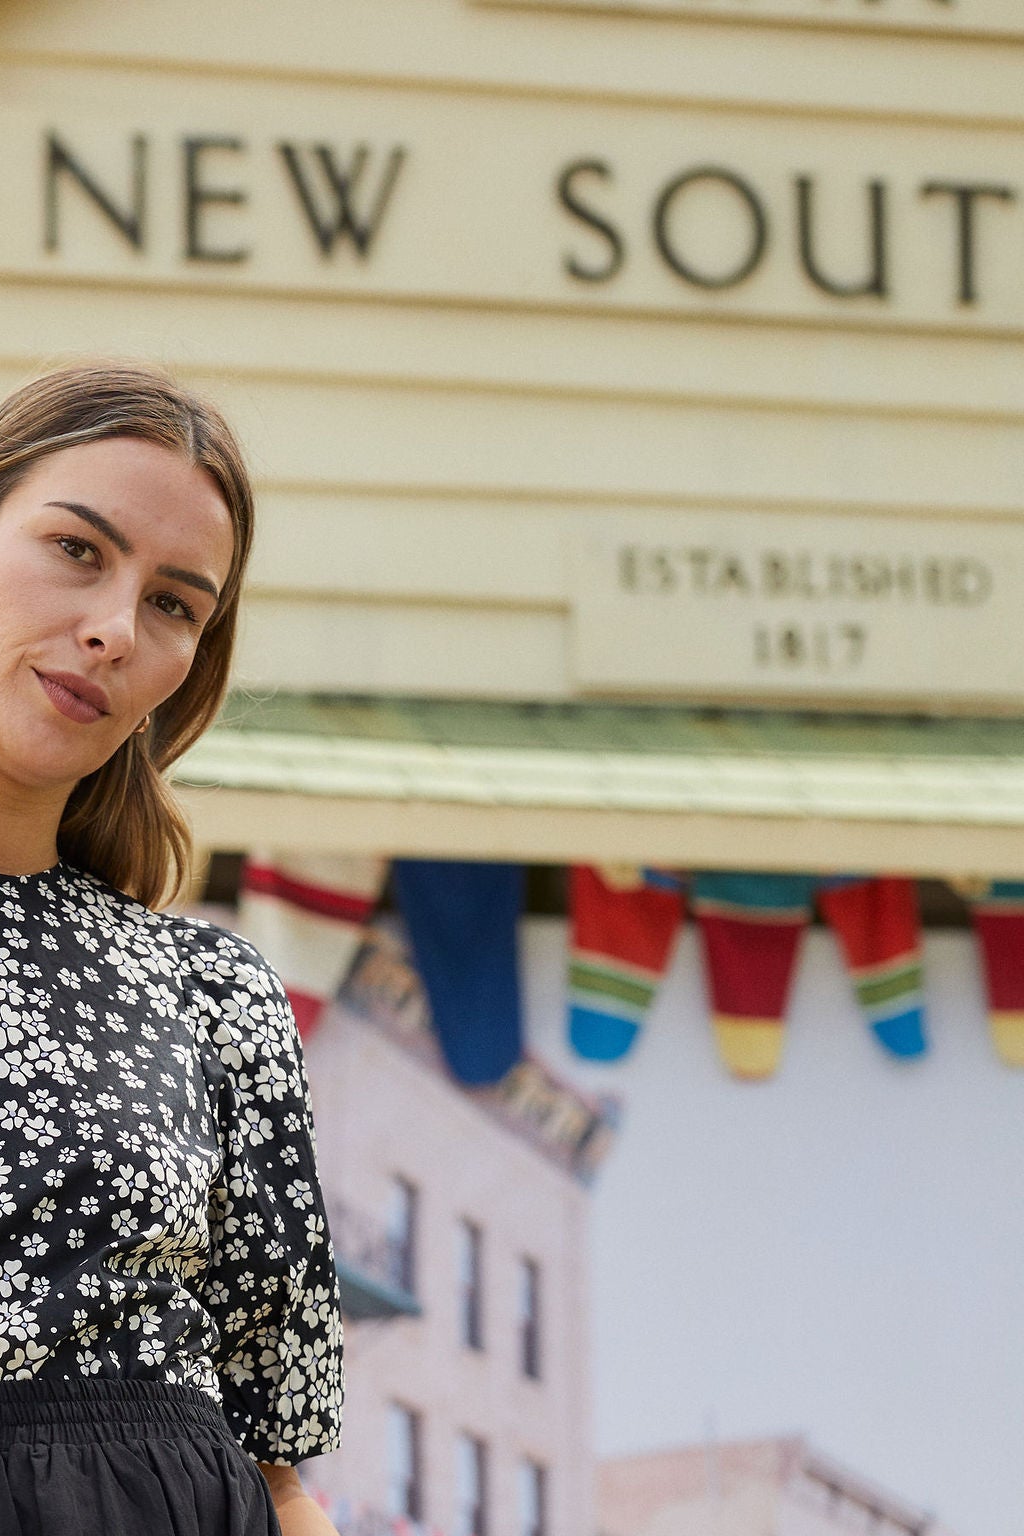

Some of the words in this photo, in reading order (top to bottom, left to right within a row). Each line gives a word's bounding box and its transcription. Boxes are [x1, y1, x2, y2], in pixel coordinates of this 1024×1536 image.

[39, 126, 409, 266] NEW
[556, 157, 1016, 307] SOUT
[617, 544, 994, 606] ESTABLISHED
